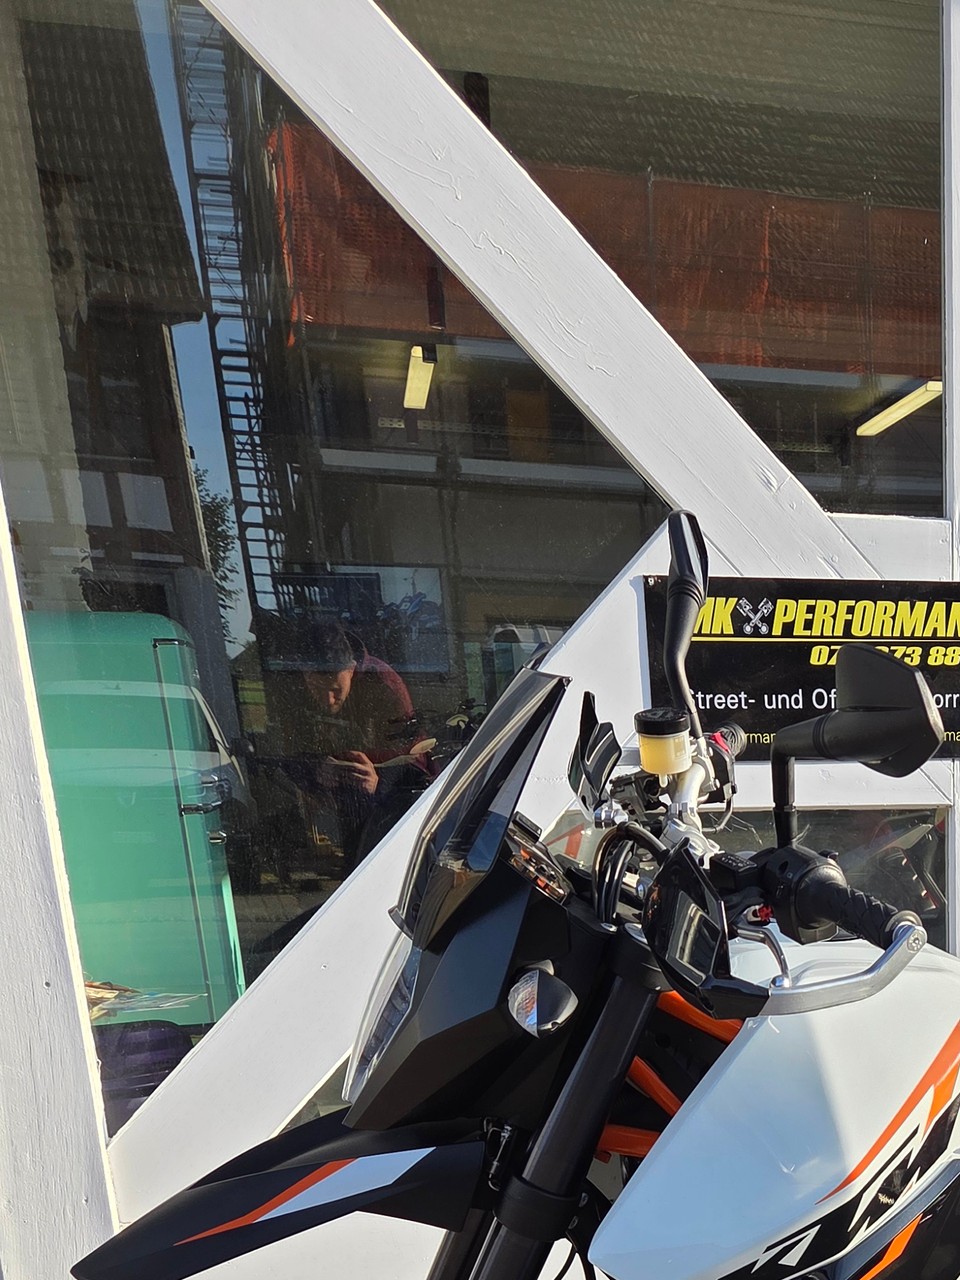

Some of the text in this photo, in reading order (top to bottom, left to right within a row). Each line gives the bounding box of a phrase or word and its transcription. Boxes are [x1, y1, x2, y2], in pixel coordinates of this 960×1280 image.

[927, 646, 960, 666] 88
[690, 688, 755, 710] treet-
[764, 688, 803, 709] und
[812, 688, 837, 710] Of
